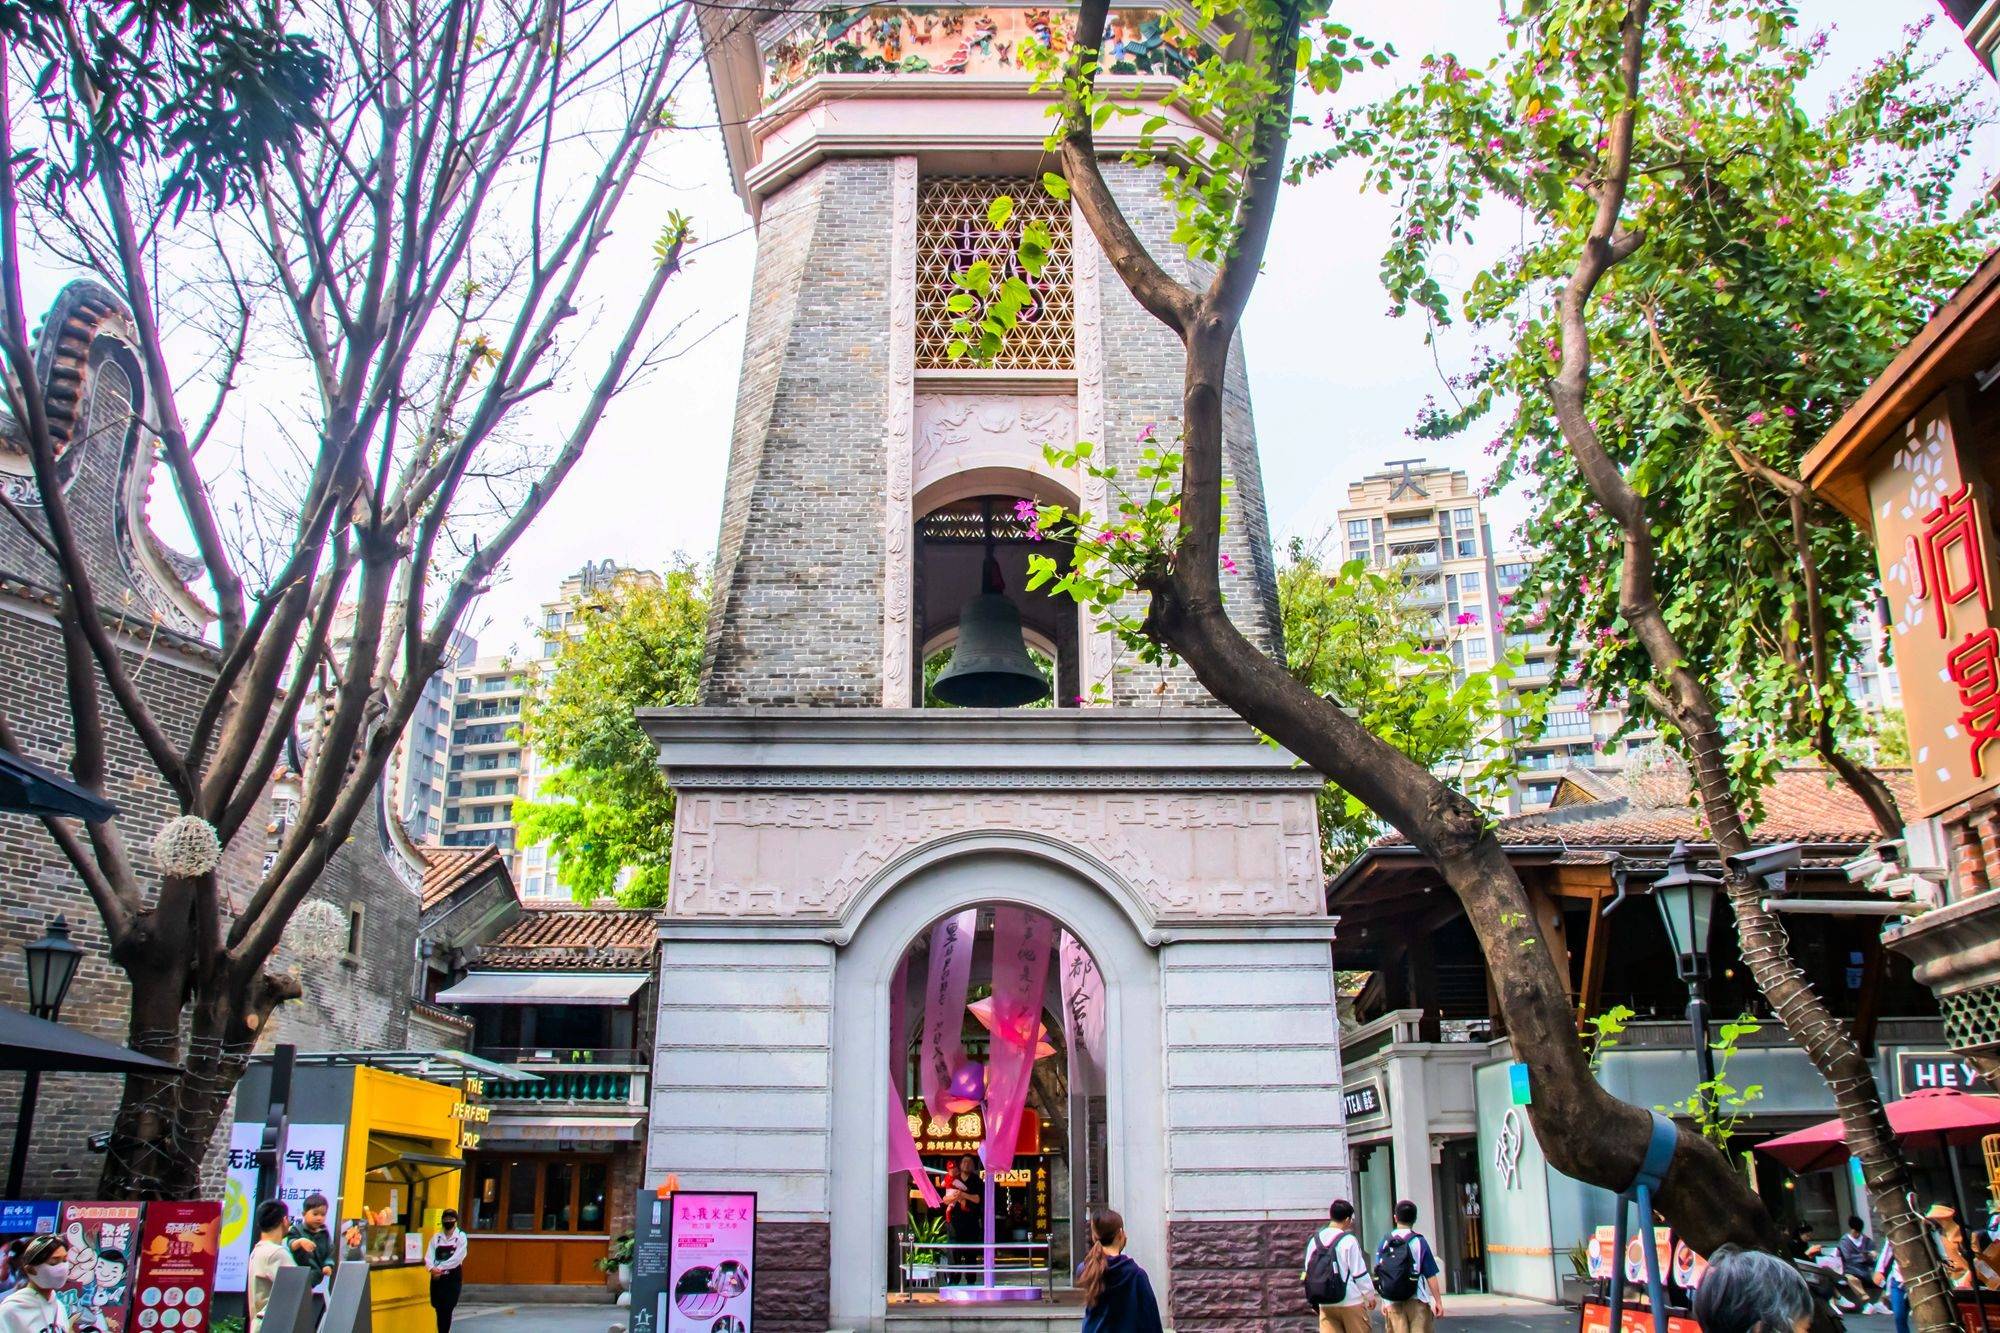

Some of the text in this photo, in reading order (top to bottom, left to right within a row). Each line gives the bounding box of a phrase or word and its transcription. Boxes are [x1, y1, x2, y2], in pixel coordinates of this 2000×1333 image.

[1915, 1063, 1978, 1086] HEY
[467, 1077, 484, 1095] THE
[453, 1102, 490, 1122] PERFECT
[462, 1132, 480, 1148] POP
